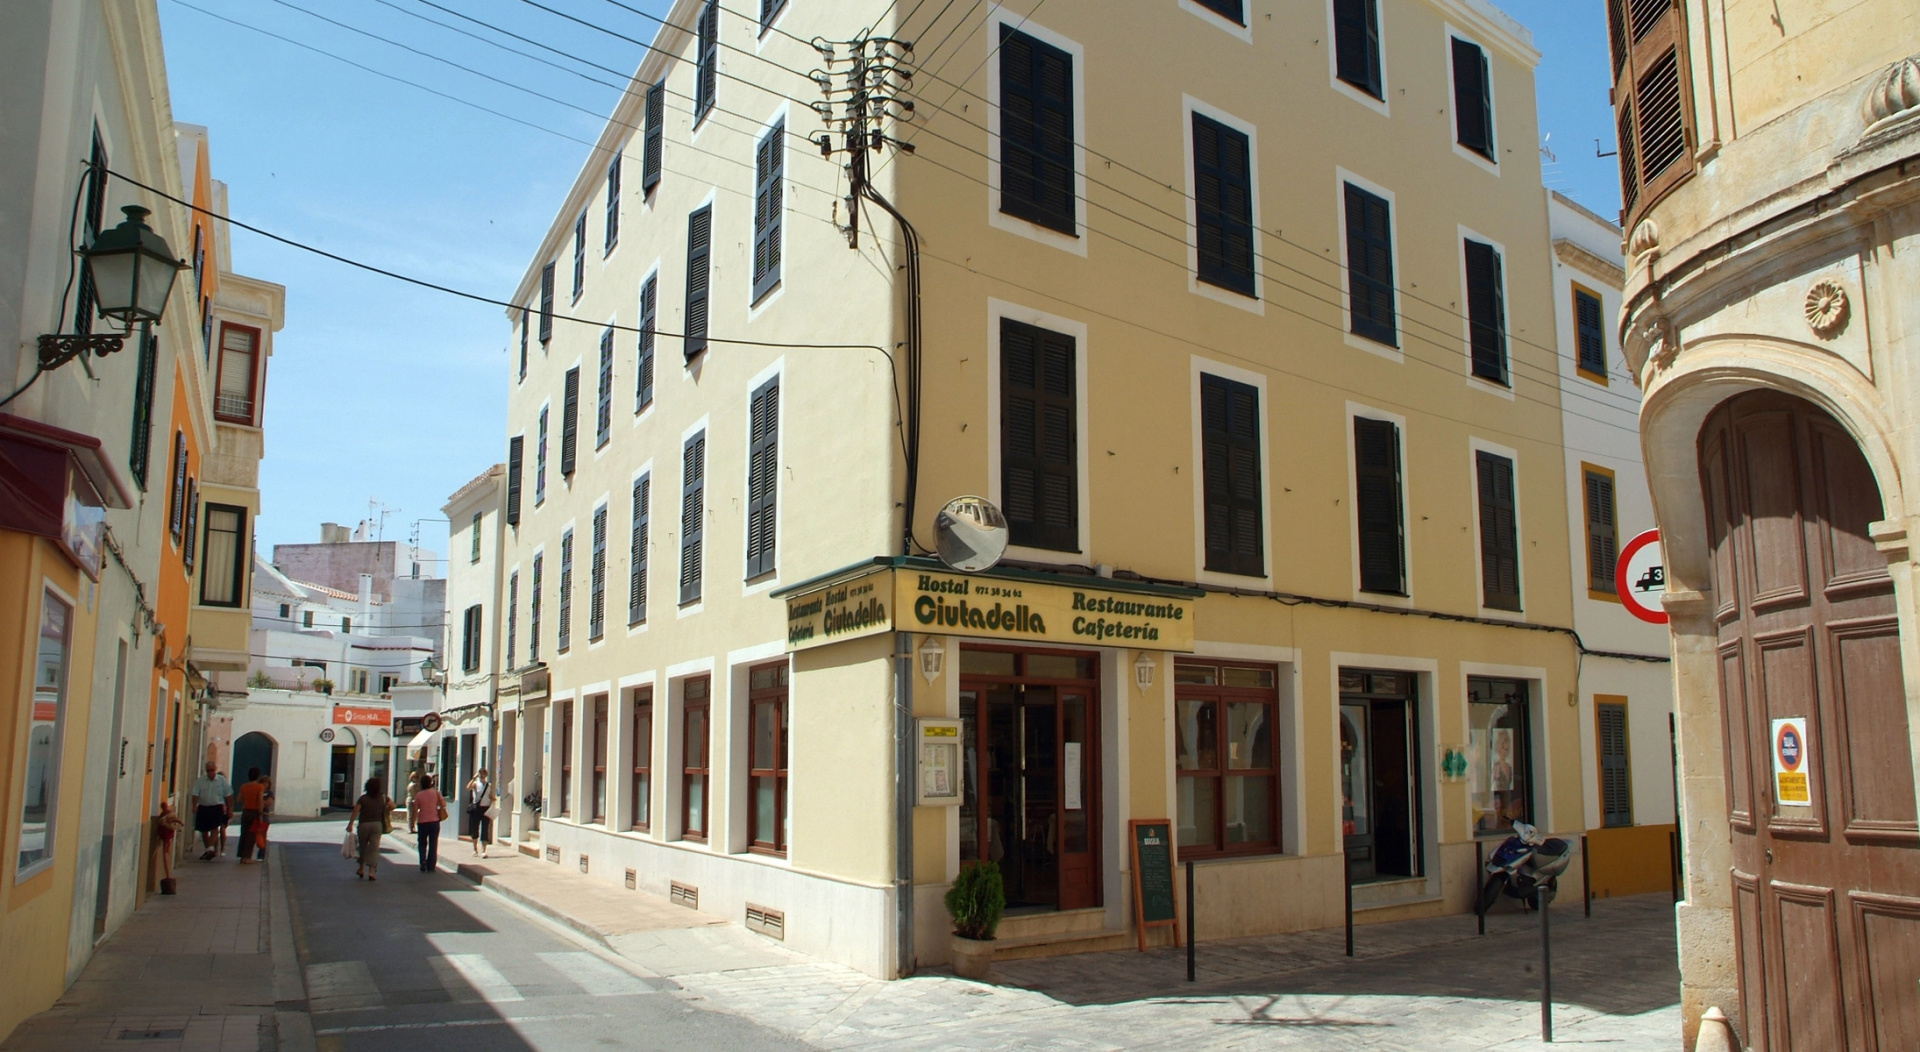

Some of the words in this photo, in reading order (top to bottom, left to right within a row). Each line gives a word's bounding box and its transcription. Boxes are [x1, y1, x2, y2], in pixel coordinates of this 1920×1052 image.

[825, 585, 848, 607] Hostal
[917, 574, 969, 595] Hostal
[975, 585, 988, 595] 971
[990, 586, 1001, 596] 38
[1002, 588, 1011, 598] 34
[1012, 588, 1022, 598] 62
[823, 597, 886, 637] Ciutadella
[914, 595, 1046, 634] Ciutadella
[1071, 591, 1184, 620] Restaurante
[1072, 616, 1159, 641] Cafetería
